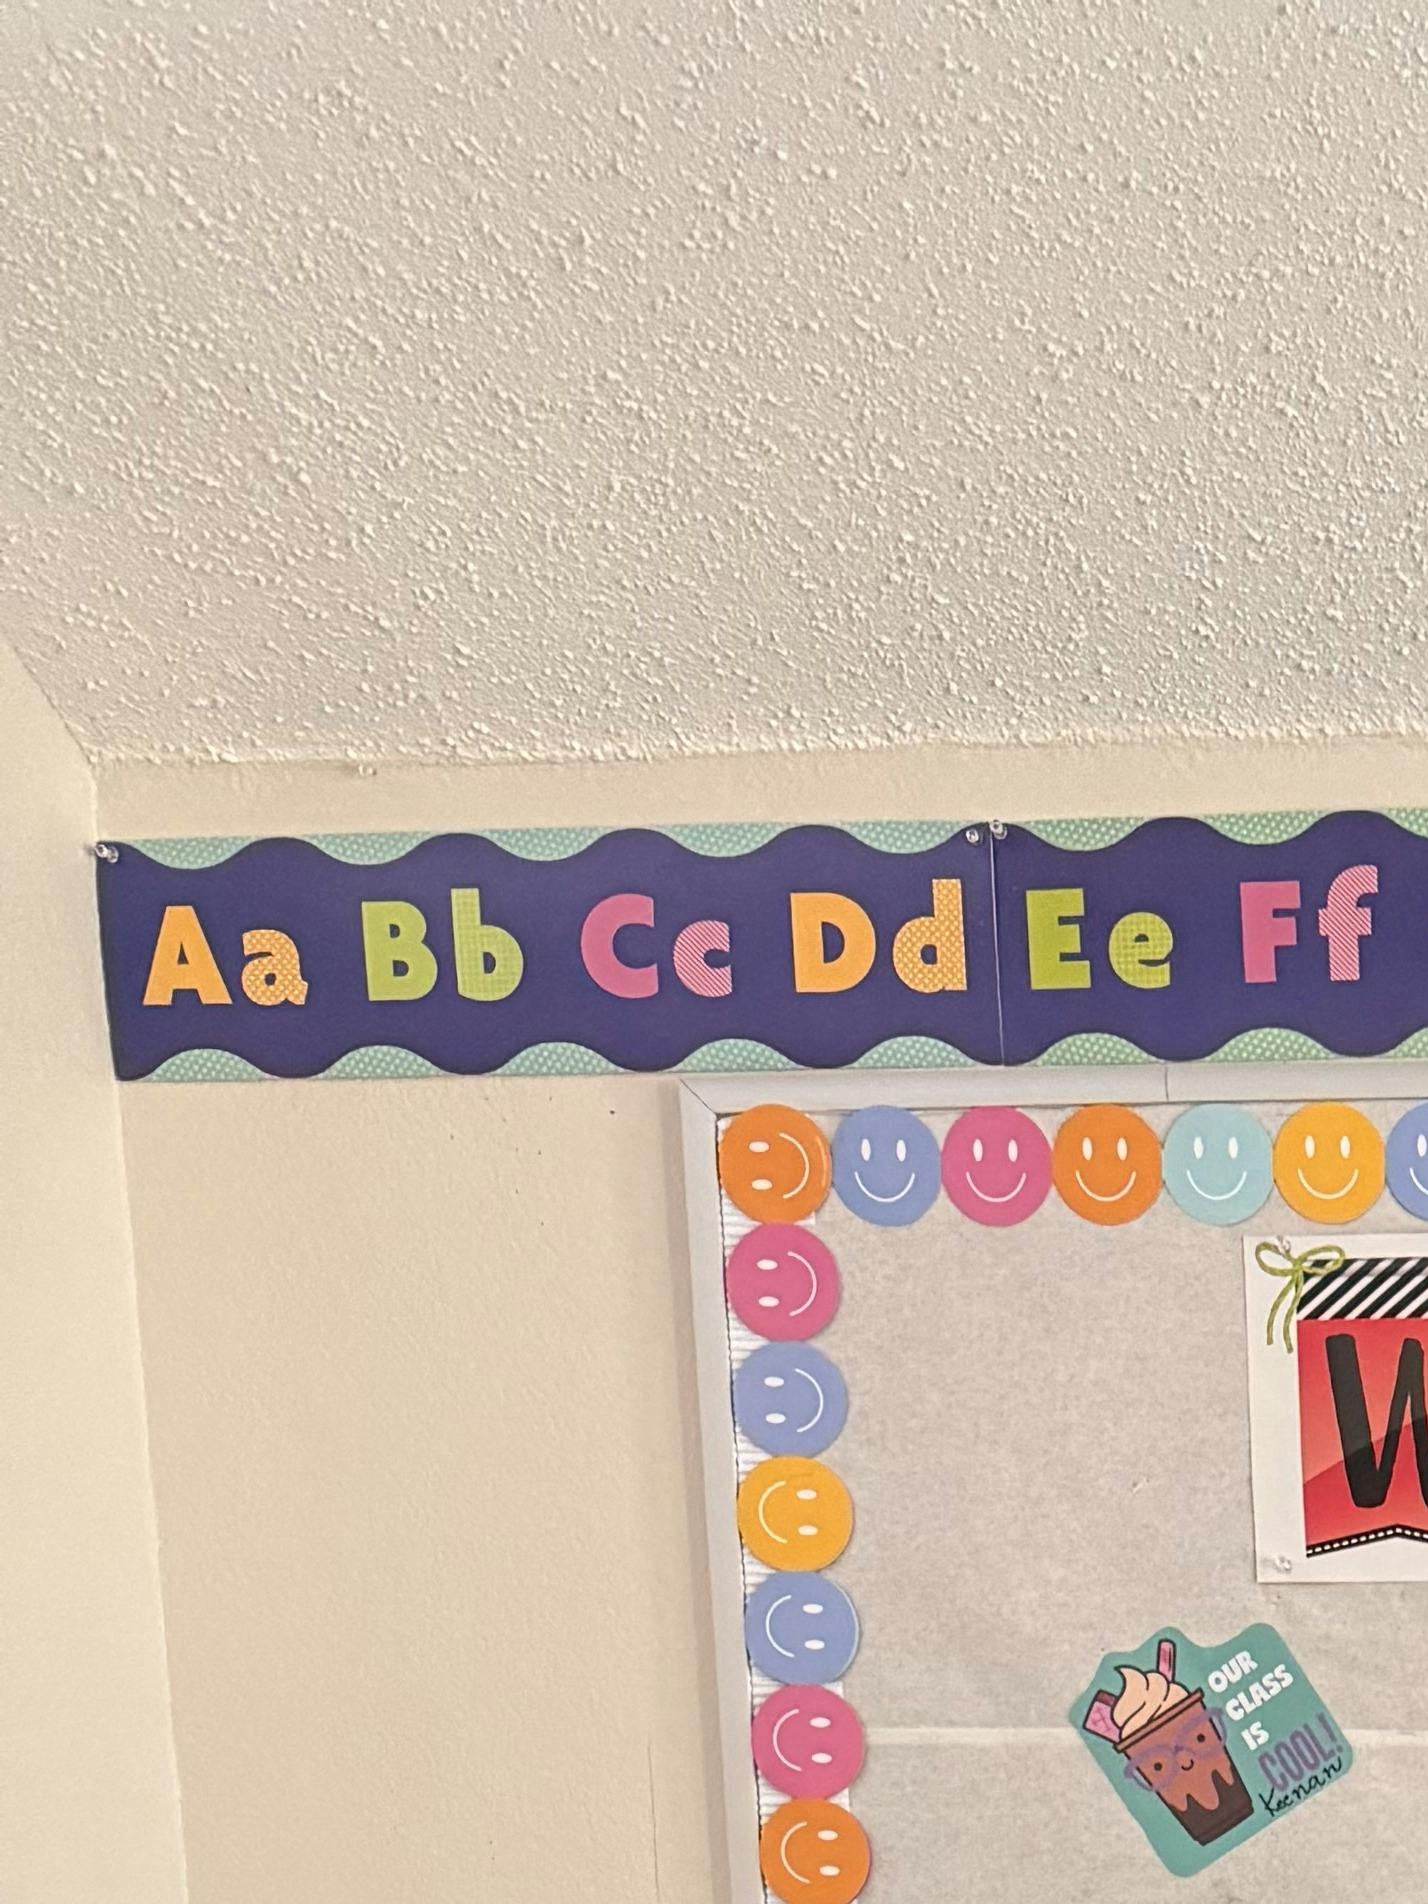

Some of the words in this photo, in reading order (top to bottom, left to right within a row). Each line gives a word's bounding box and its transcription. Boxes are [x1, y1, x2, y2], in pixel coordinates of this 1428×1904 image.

[144, 905, 307, 1007] Aa
[364, 888, 522, 998] Bb
[580, 895, 730, 999] Cc
[789, 880, 966, 994] Dd
[1026, 889, 1172, 988] Ee
[1239, 868, 1376, 984] Ff
[1207, 1651, 1258, 1693] OUR
[1225, 1664, 1294, 1721] CLASS
[1240, 1721, 1270, 1751] IS
[1258, 1712, 1343, 1791] COOL!
